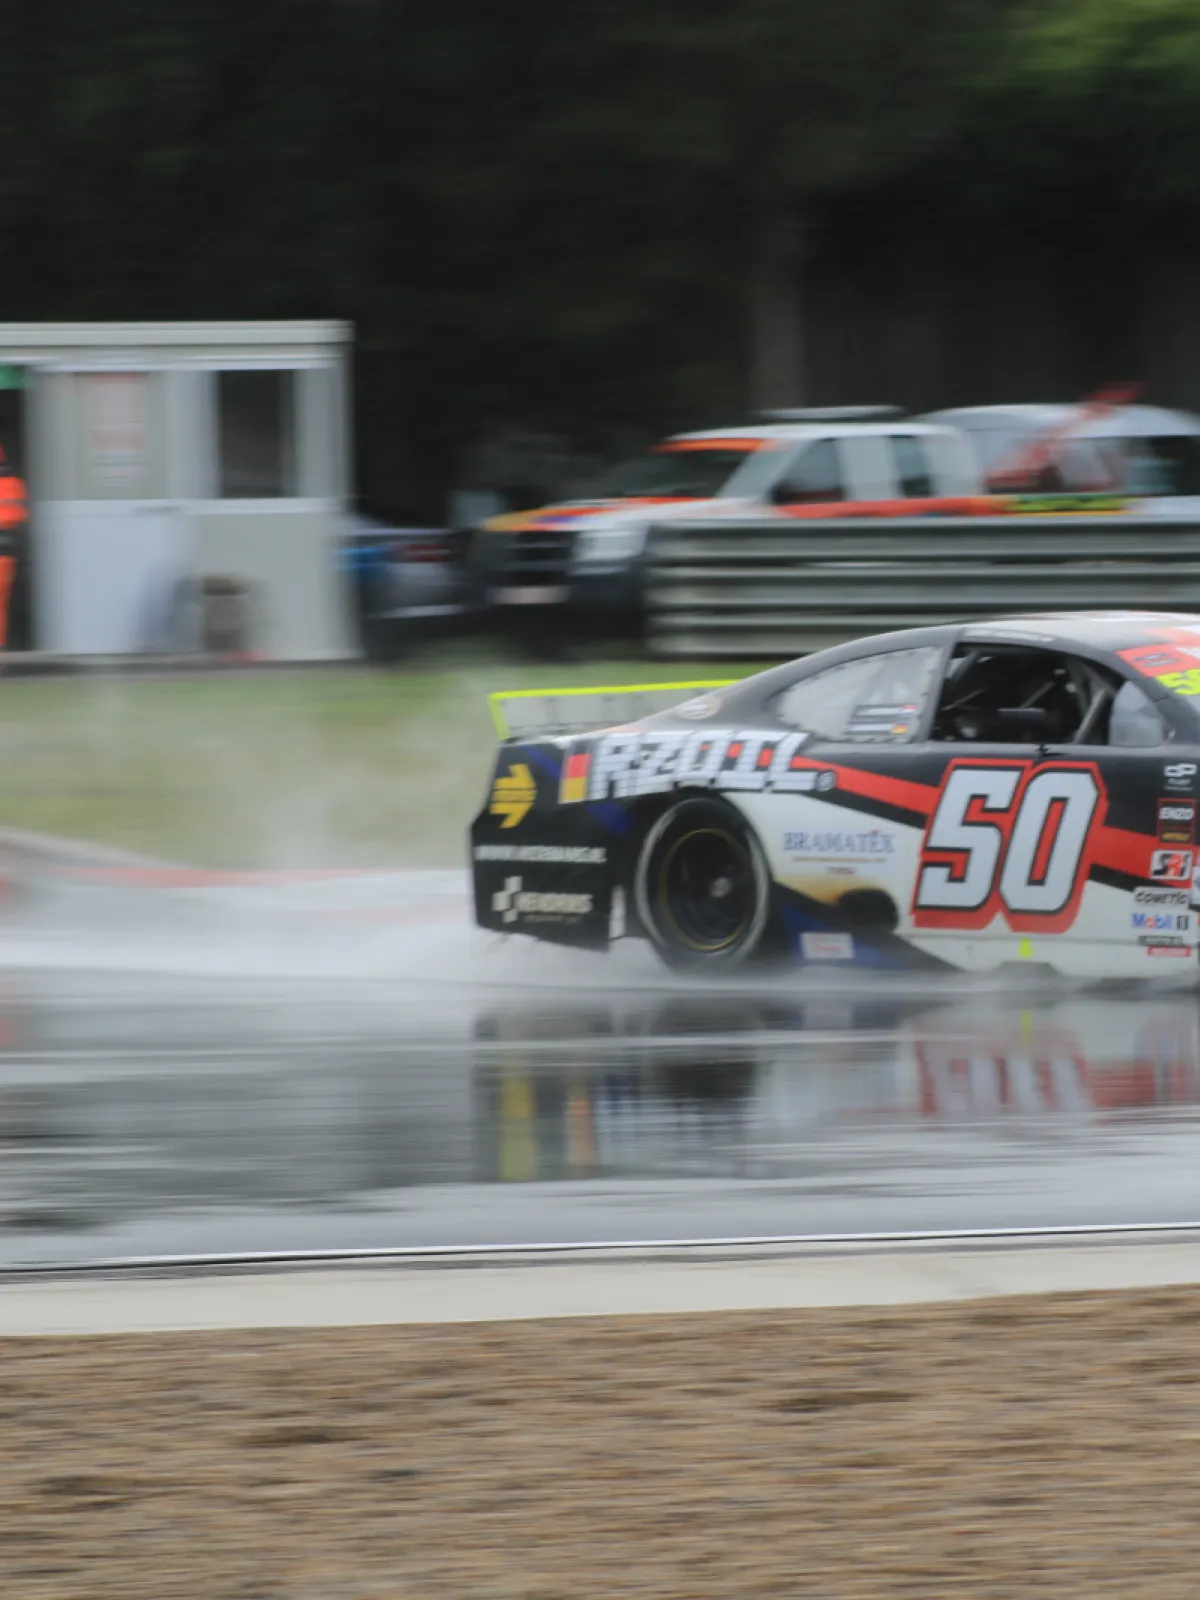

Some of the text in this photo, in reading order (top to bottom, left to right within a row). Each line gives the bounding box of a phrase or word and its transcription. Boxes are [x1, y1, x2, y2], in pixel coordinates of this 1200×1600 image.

[912, 762, 1104, 925] 50
[1135, 891, 1188, 904] COMETIC
[1132, 913, 1173, 929] Mobil
[1176, 915, 1189, 931] 1
